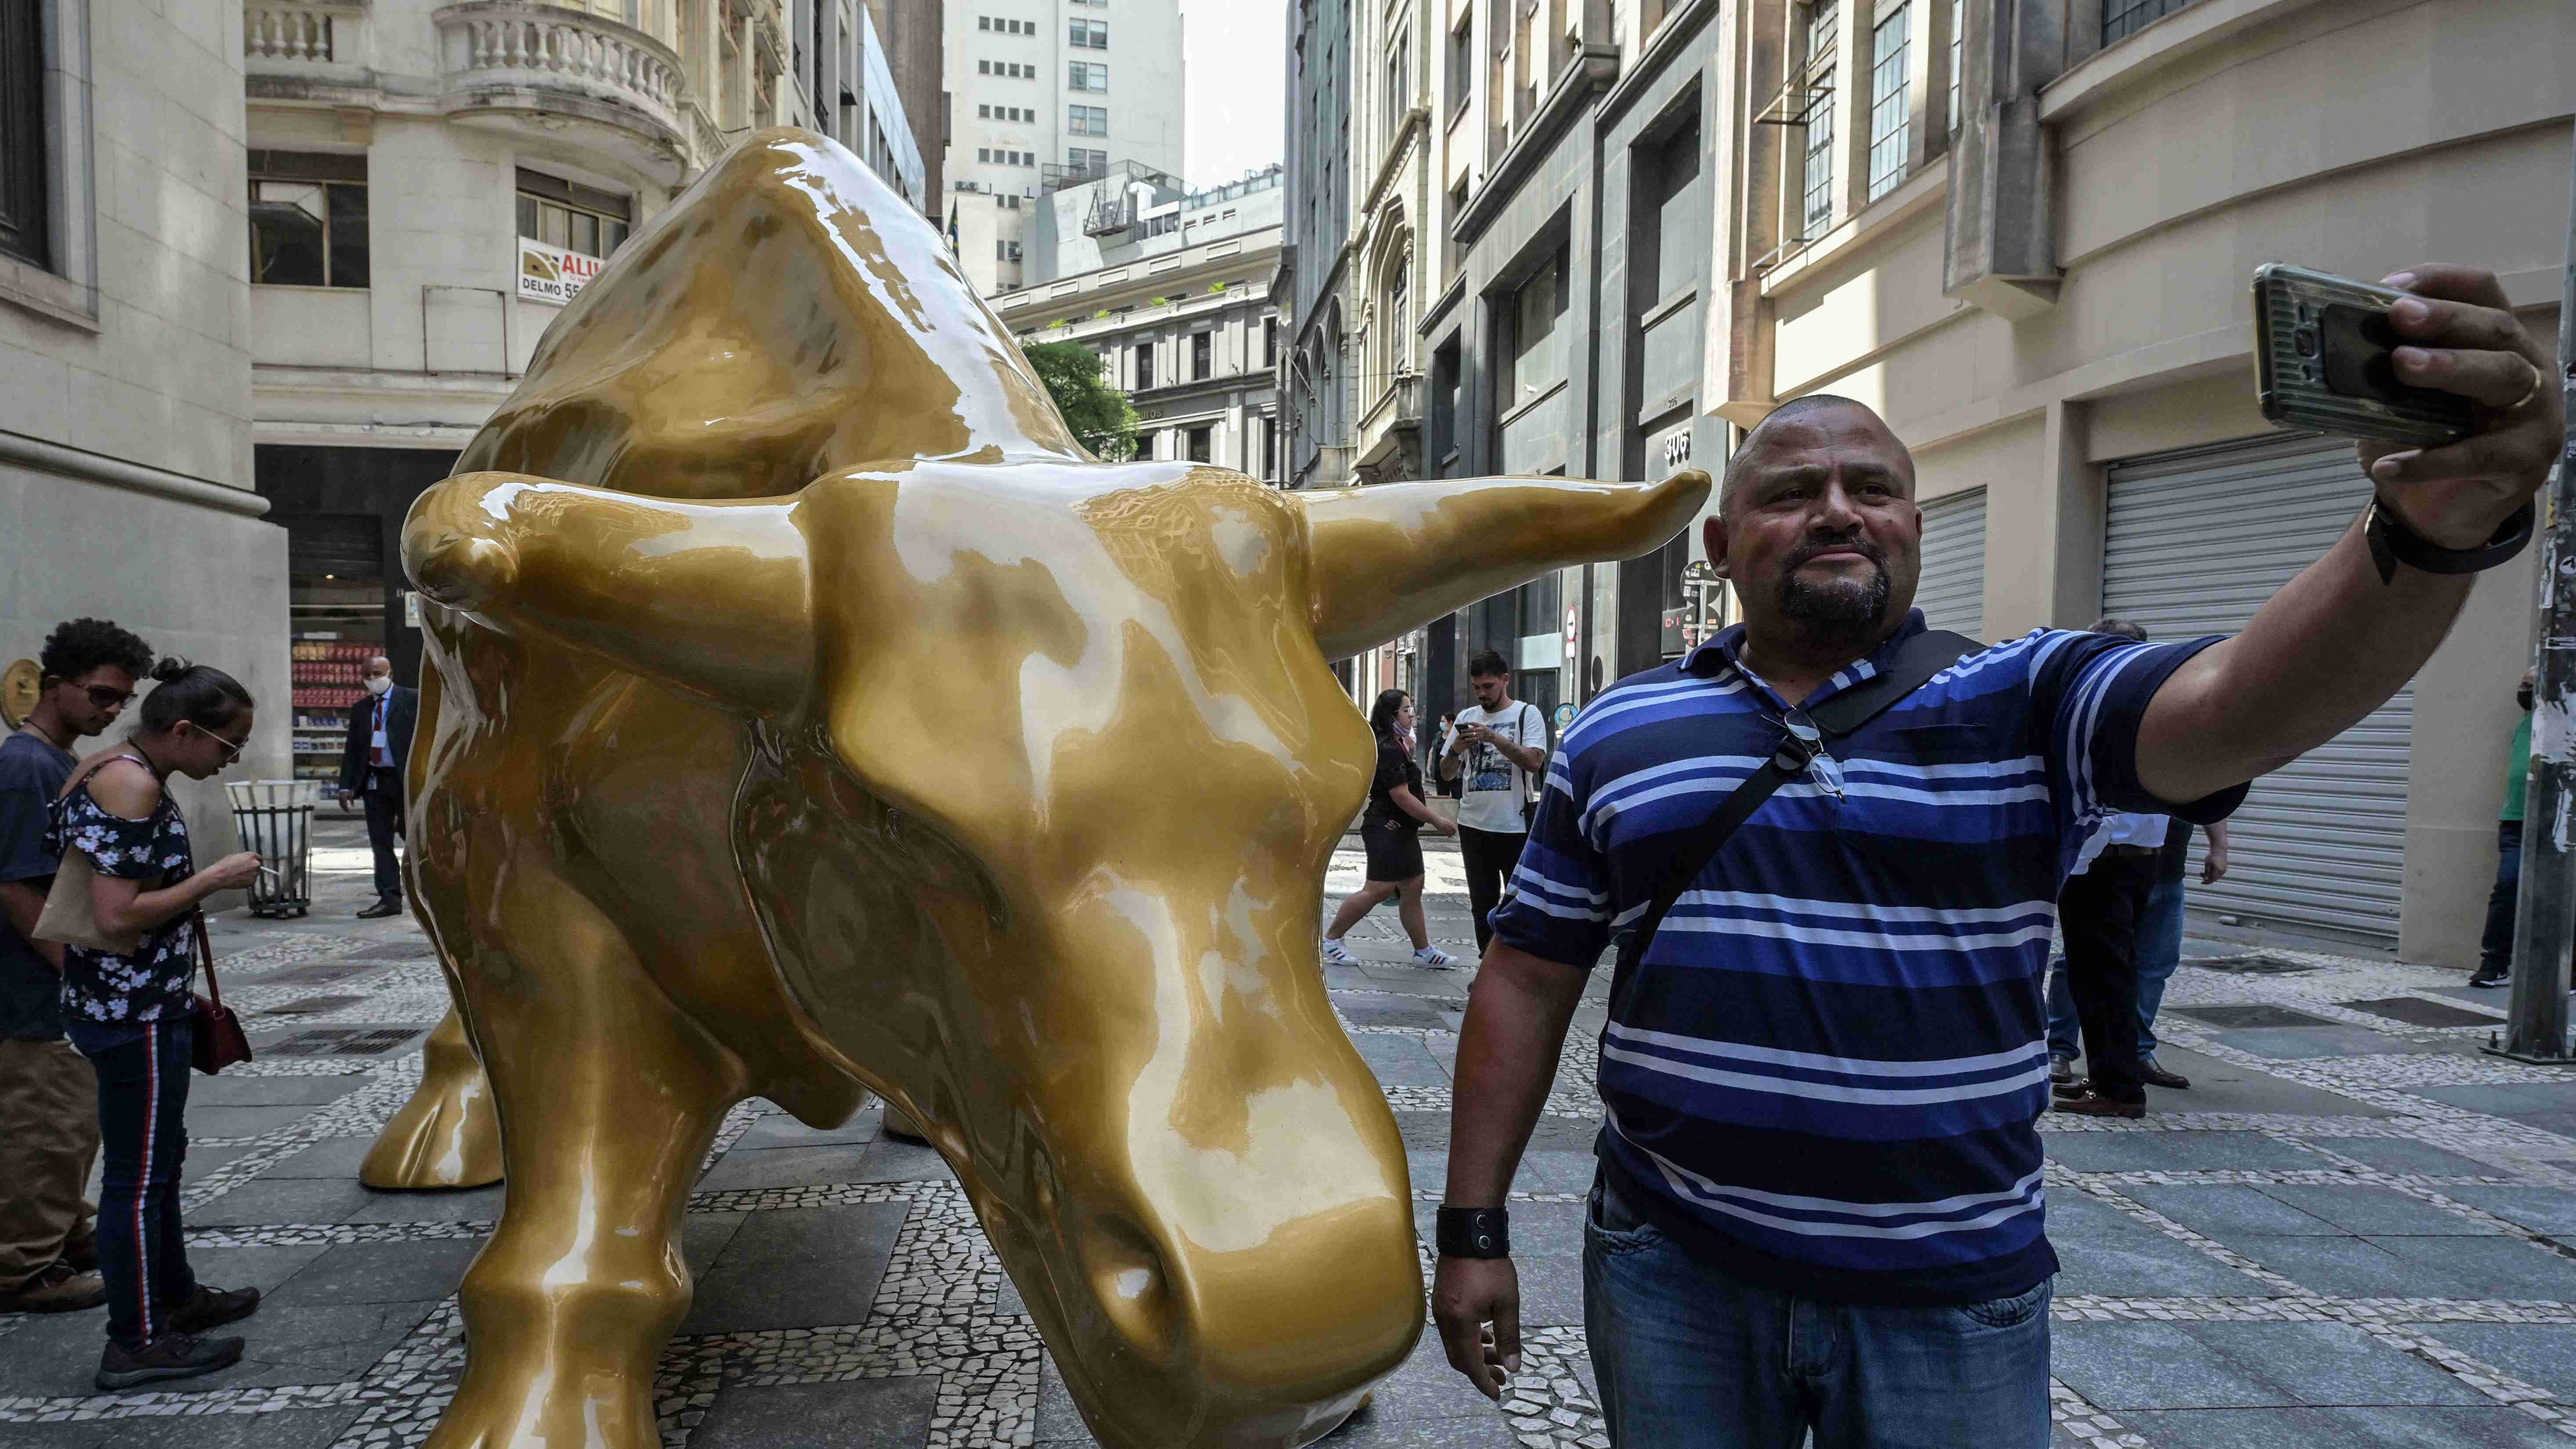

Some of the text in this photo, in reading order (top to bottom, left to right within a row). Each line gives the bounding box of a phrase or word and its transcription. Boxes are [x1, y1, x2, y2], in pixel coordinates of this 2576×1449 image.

[523, 278, 561, 295] DELMO
[1139, 409, 1162, 420] uros
[1664, 427, 1689, 460] 306
